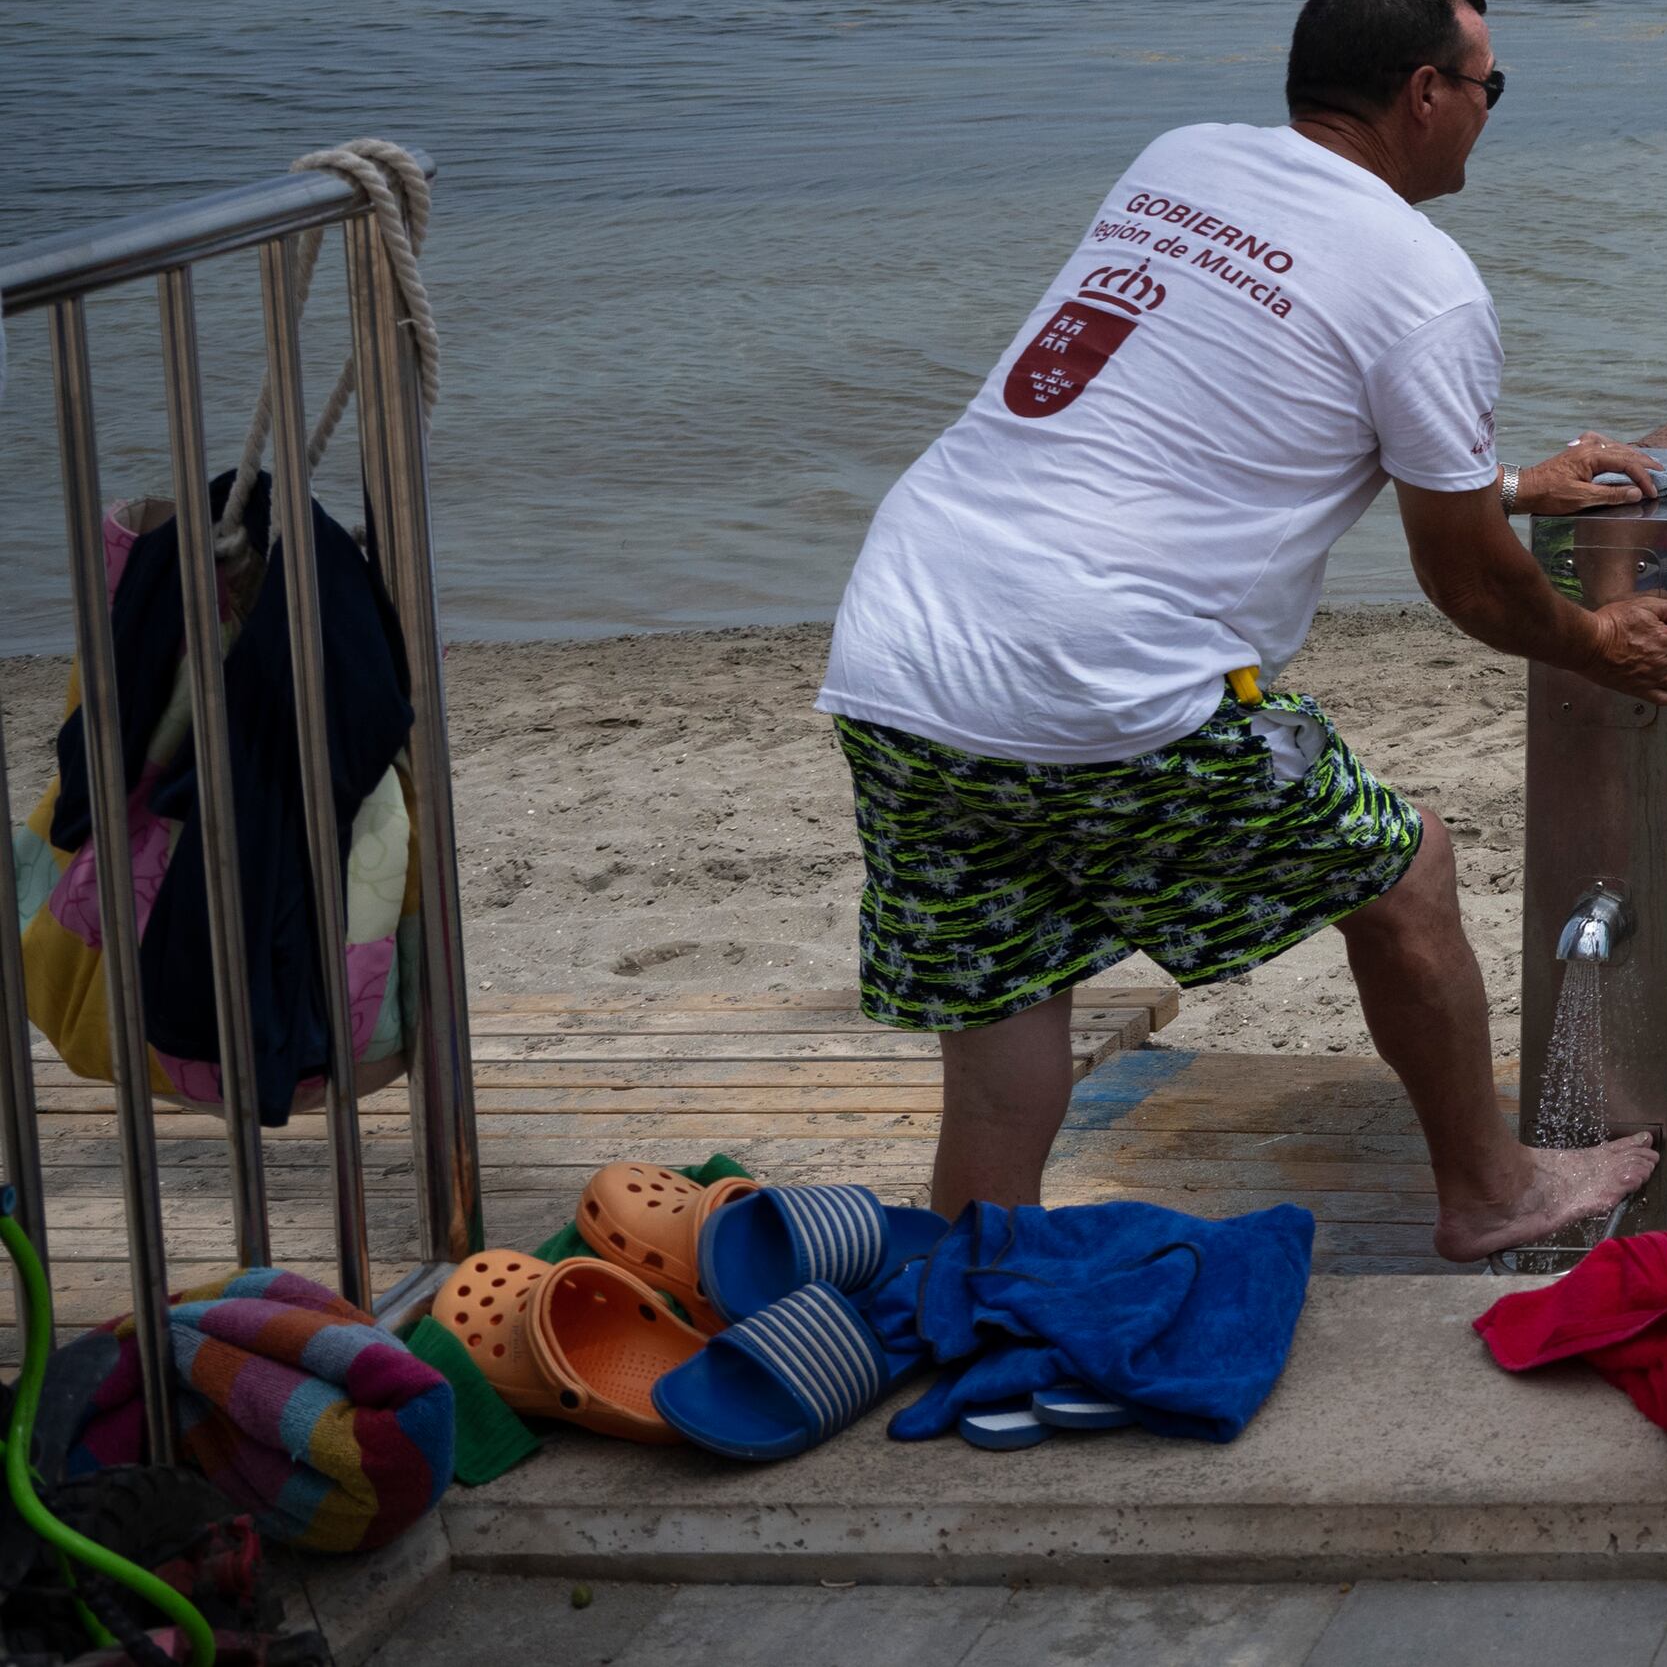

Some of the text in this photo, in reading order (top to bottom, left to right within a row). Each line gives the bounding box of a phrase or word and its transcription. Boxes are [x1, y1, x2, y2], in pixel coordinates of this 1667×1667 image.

[1126, 193, 1294, 274] GOBIERNO
[1152, 236, 1189, 259] de
[1190, 249, 1293, 319] Murcia
